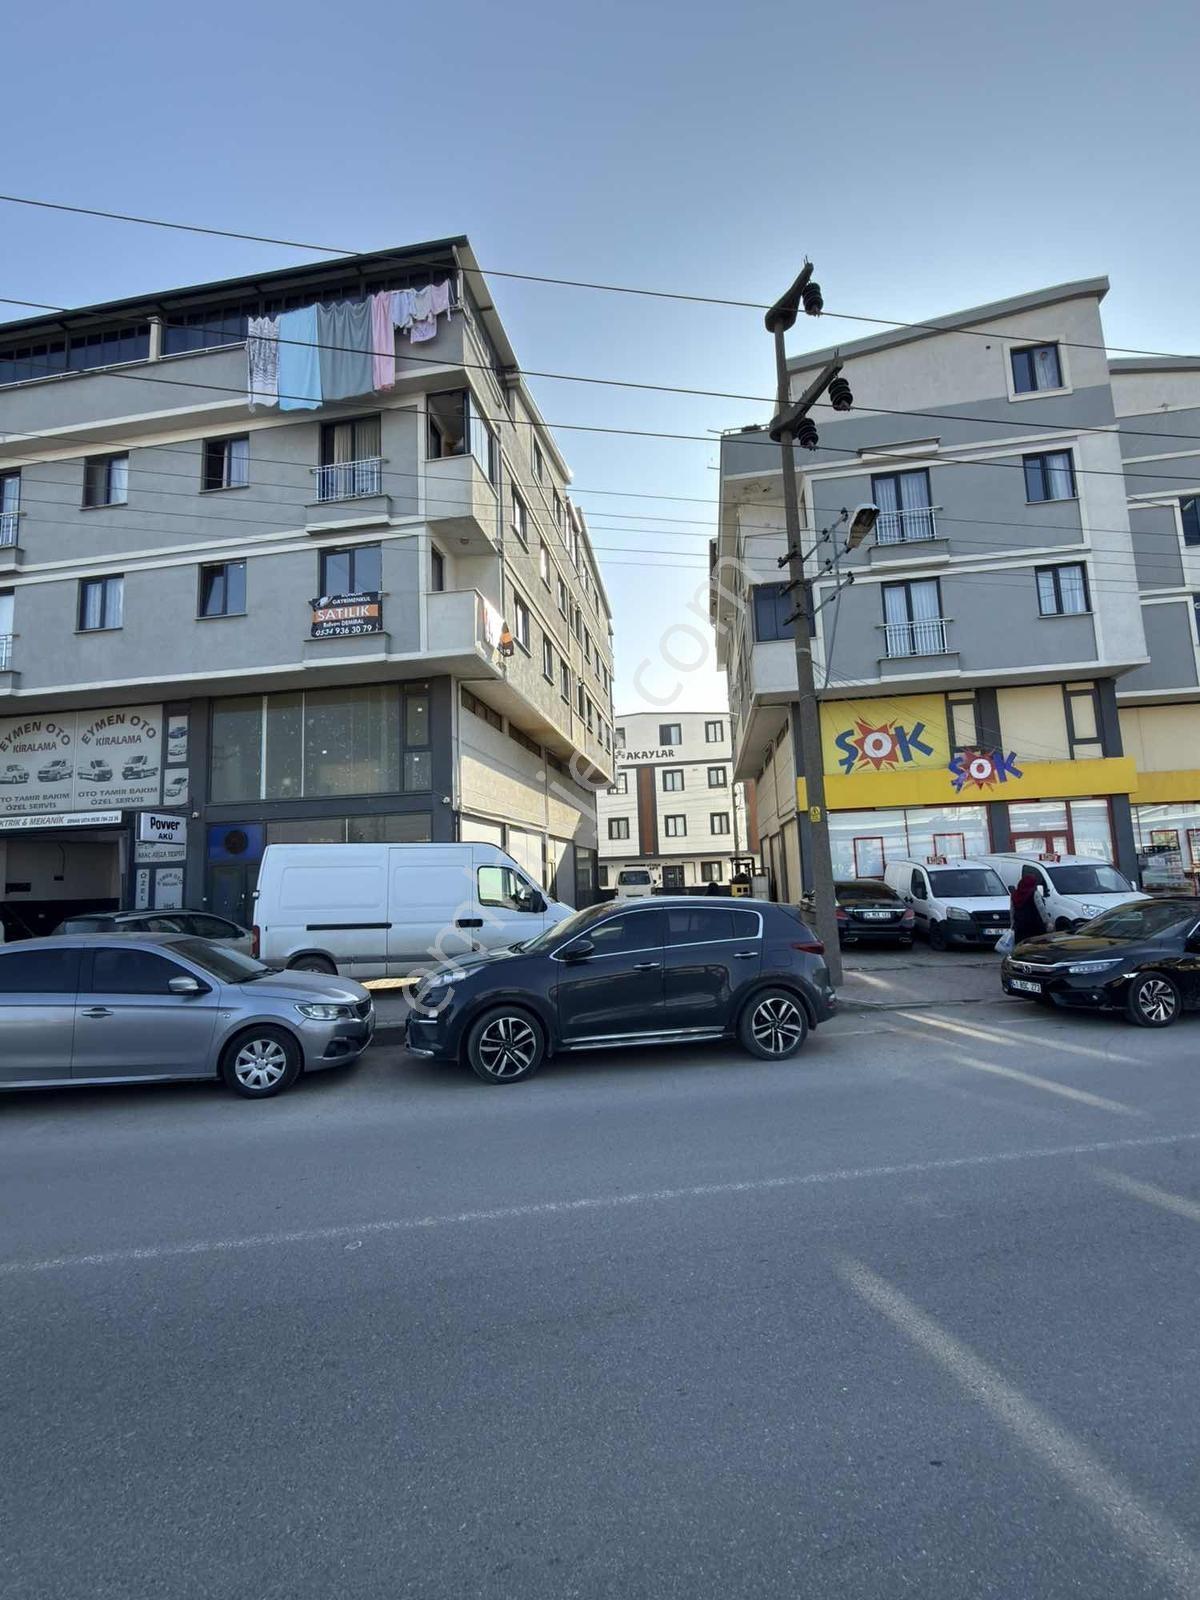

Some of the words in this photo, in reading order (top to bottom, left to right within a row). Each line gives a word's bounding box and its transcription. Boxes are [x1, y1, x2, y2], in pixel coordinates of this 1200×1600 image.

[317, 605, 369, 621] SATILIK
[0, 721, 42, 753] EYMEN
[46, 723, 70, 746] OTO
[81, 713, 125, 745] EYMEN
[130, 716, 156, 739] OTO
[626, 749, 675, 760] AKAYLAR
[835, 721, 934, 775] ŞOK
[948, 751, 1023, 794] ŞOK
